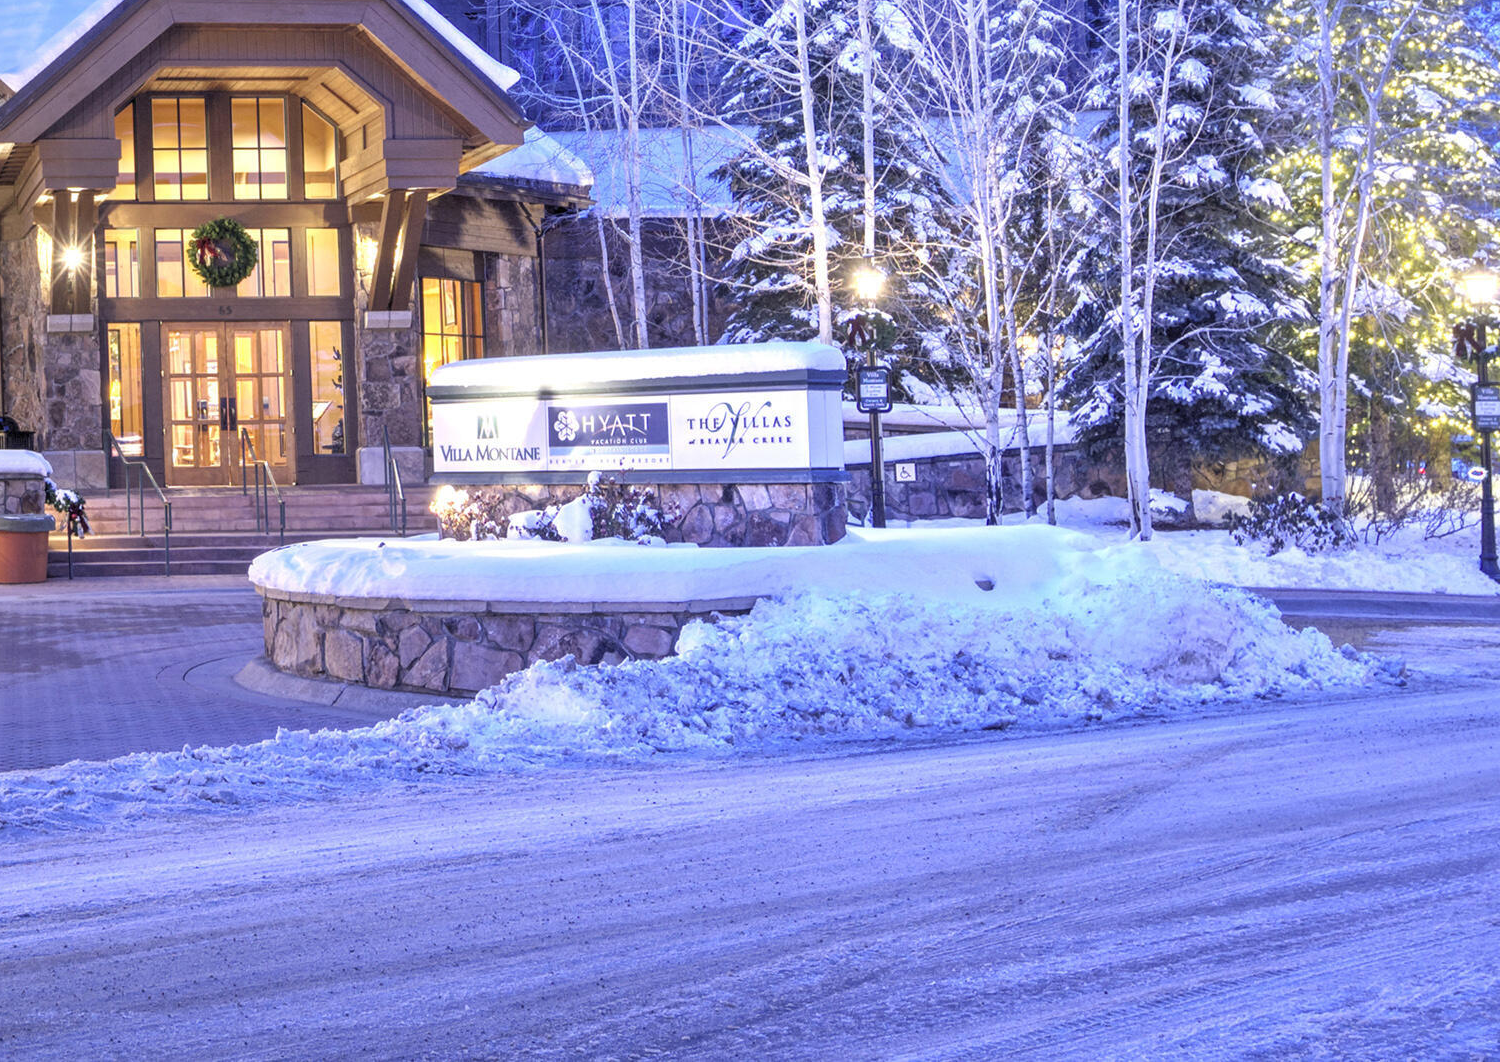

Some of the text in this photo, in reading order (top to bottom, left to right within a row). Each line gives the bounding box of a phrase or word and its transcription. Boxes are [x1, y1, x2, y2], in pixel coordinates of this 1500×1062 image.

[582, 413, 651, 436] HYATT
[687, 418, 720, 430] THE
[590, 437, 648, 446] VACATION CLUB
[752, 436, 793, 445] CREEK
[440, 444, 541, 462] VILLA MONTANE
